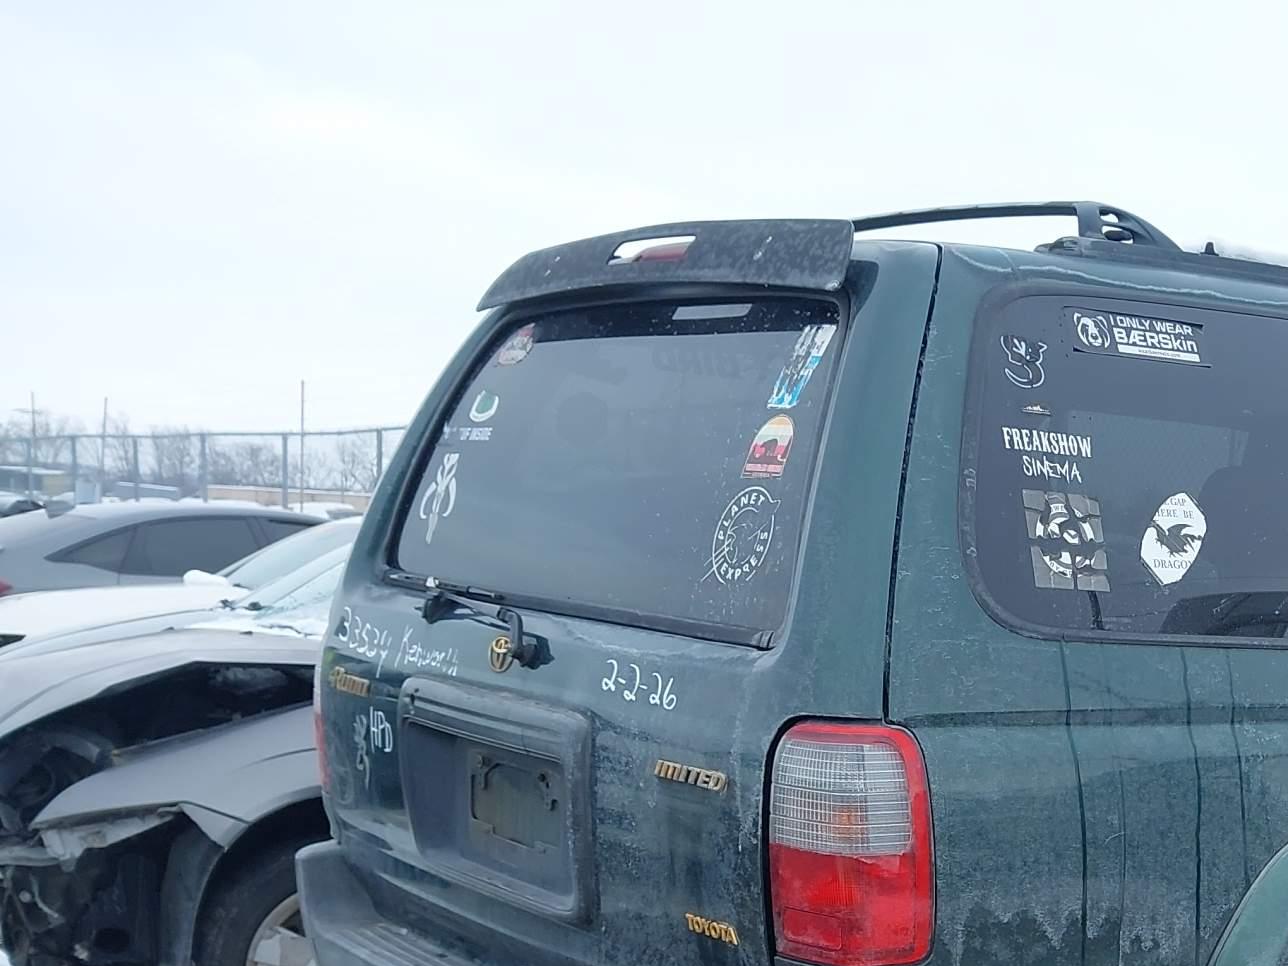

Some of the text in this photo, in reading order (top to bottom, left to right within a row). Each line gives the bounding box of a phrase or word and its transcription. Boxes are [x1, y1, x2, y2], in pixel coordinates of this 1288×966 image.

[1116, 316, 1150, 330] ONLY
[1152, 321, 1193, 336] WEAR
[1002, 426, 1092, 458] FREAKSHOW
[1022, 455, 1083, 484] SINEMA
[717, 492, 766, 540] PLANET
[720, 531, 769, 581] EXPRESS
[601, 659, 677, 710] 2-2-26
[685, 913, 738, 946] TOYOTA
